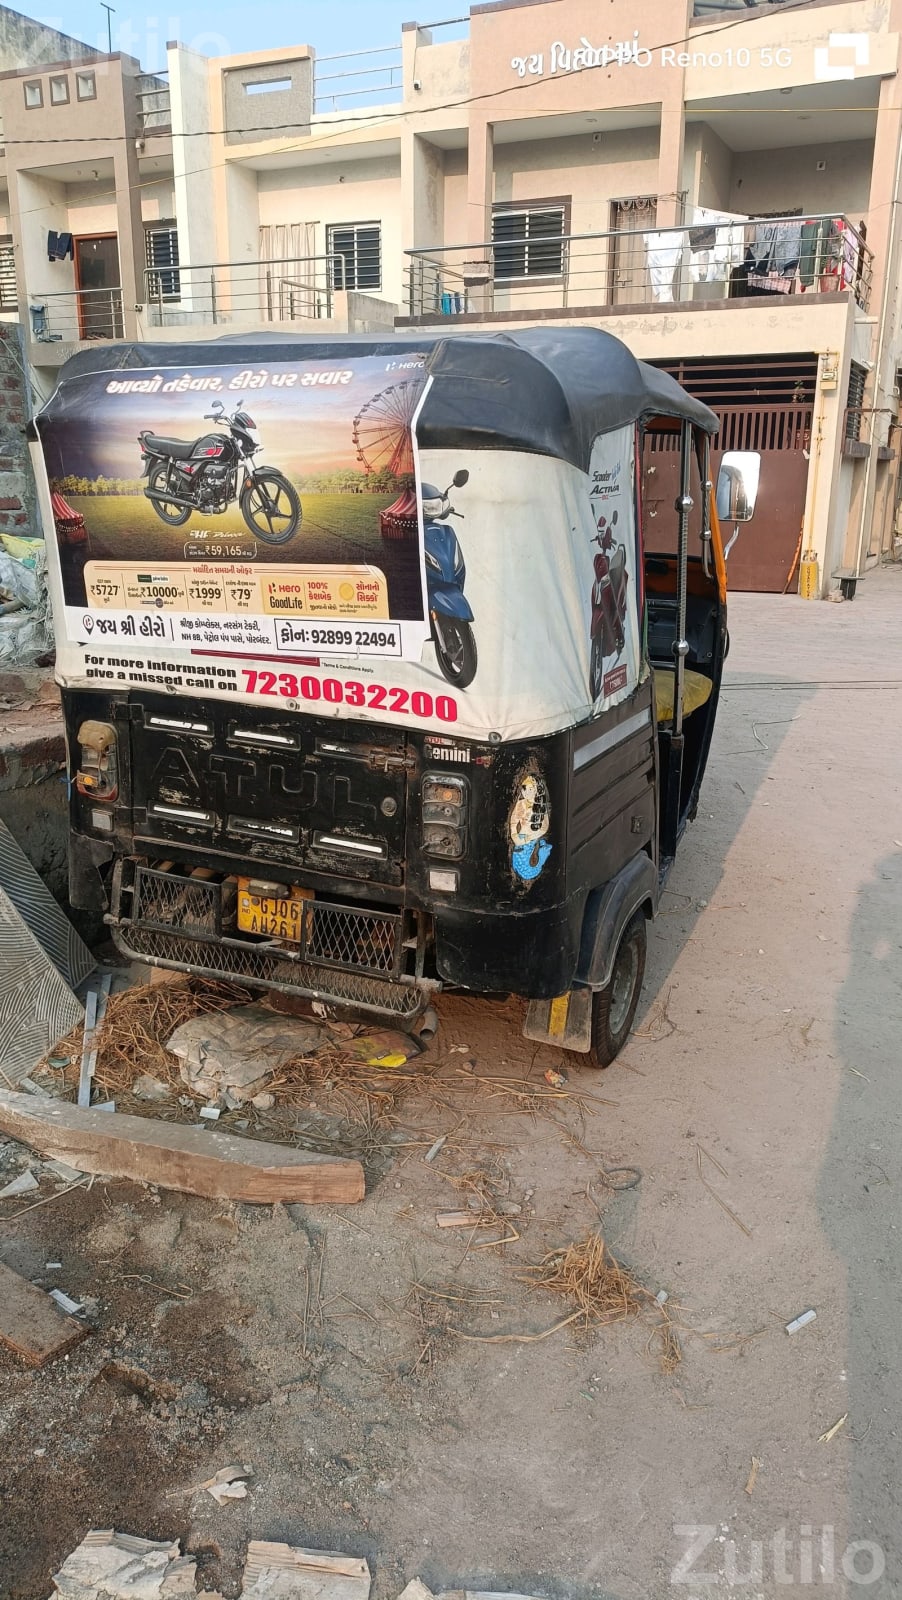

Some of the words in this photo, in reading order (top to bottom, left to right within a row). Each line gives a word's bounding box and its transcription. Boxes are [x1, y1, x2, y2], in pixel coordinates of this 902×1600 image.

[511, 54, 543, 77] જય
[105, 374, 164, 394] આવ્યો
[228, 370, 269, 390] હીરો
[271, 372, 298, 387] પર
[300, 370, 352, 386] સવાર
[279, 585, 301, 593] Hero
[307, 582, 328, 590] 100%
[269, 596, 303, 609] GoodLife
[96, 619, 117, 635] જય
[121, 615, 136, 636] શ્રી
[139, 615, 166, 637] હીરો
[311, 629, 352, 645] 92899
[355, 631, 396, 647] 22494
[85, 654, 104, 665] For
[107, 657, 144, 669] more
[147, 660, 237, 677] information
[86, 668, 114, 678] give
[117, 671, 126, 680] a
[129, 672, 183, 686] missed
[186, 677, 215, 689] call
[218, 682, 238, 691] on
[241, 669, 458, 722] 7230032200
